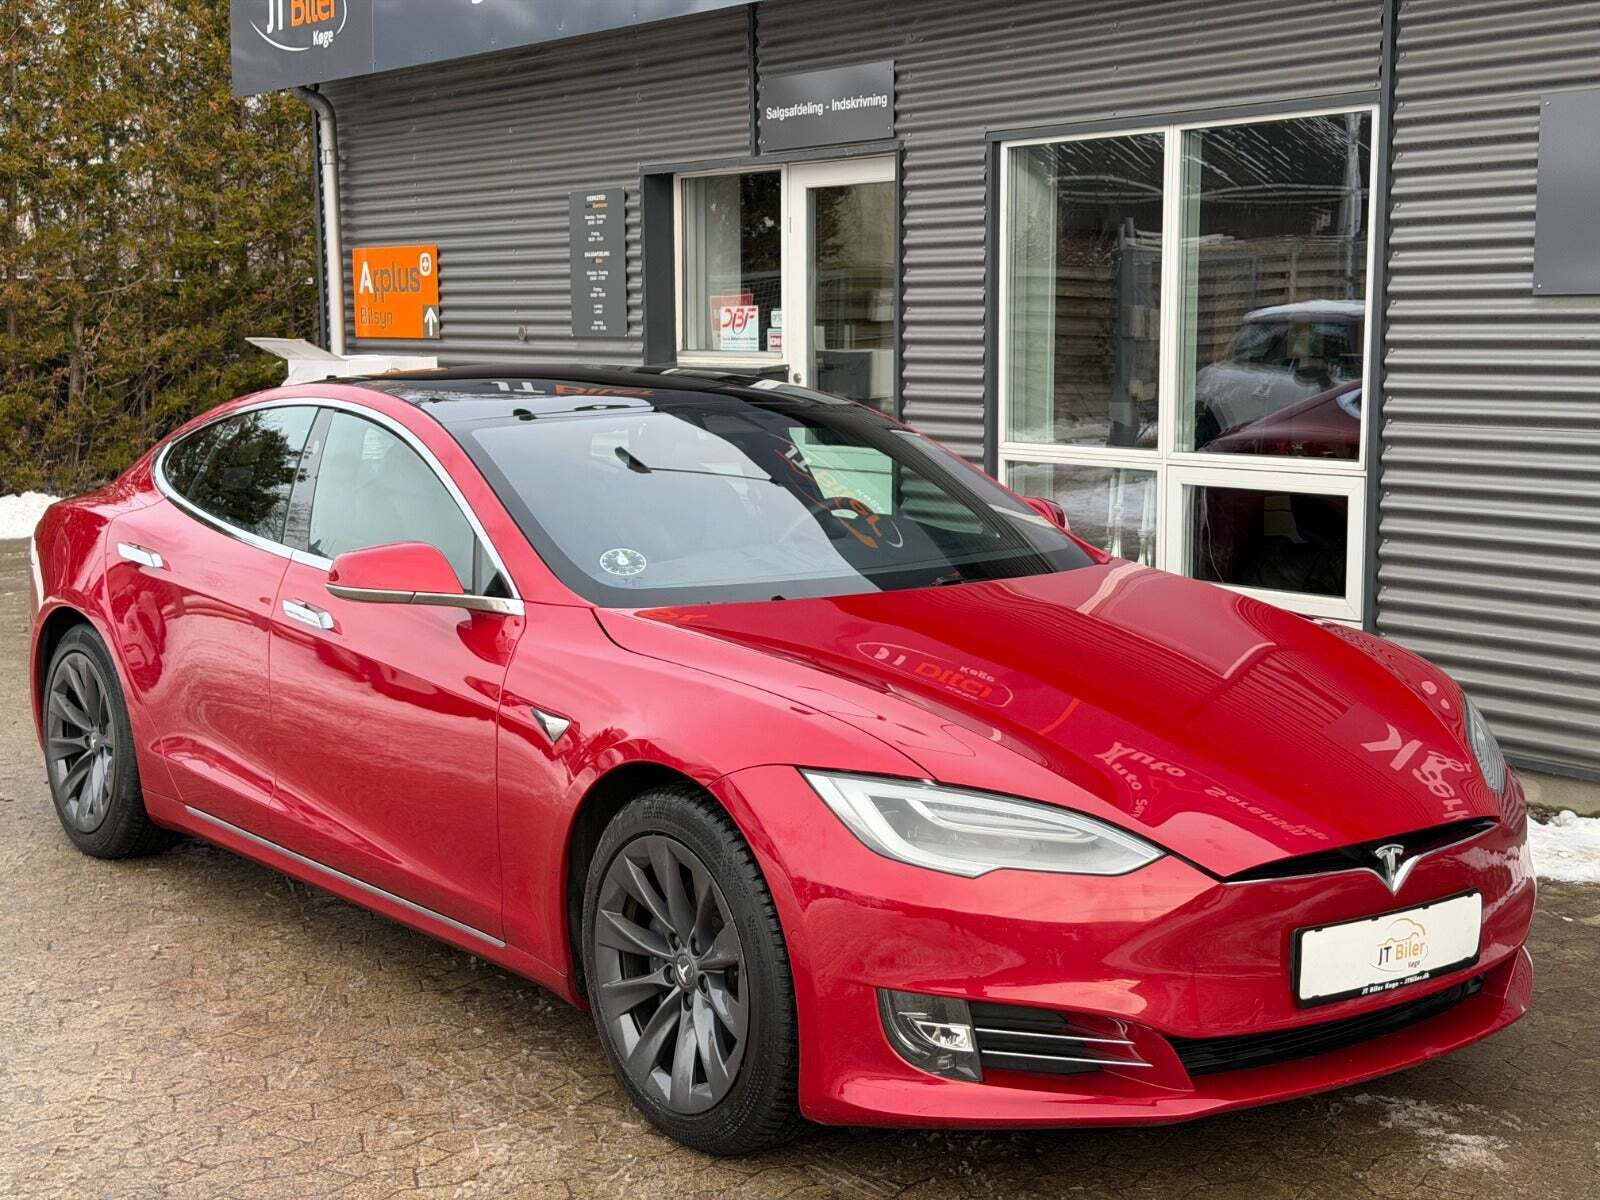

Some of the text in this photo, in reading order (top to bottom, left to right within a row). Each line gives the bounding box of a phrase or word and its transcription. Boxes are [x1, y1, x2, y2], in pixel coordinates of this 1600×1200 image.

[312, 30, 334, 48] Køge
[766, 101, 824, 121] Salgsafdeling
[831, 93, 888, 111] Indskrivning
[360, 306, 393, 328] Bilsyn
[1378, 942, 1425, 966] JT Biler
[1369, 985, 1384, 993] Biler
